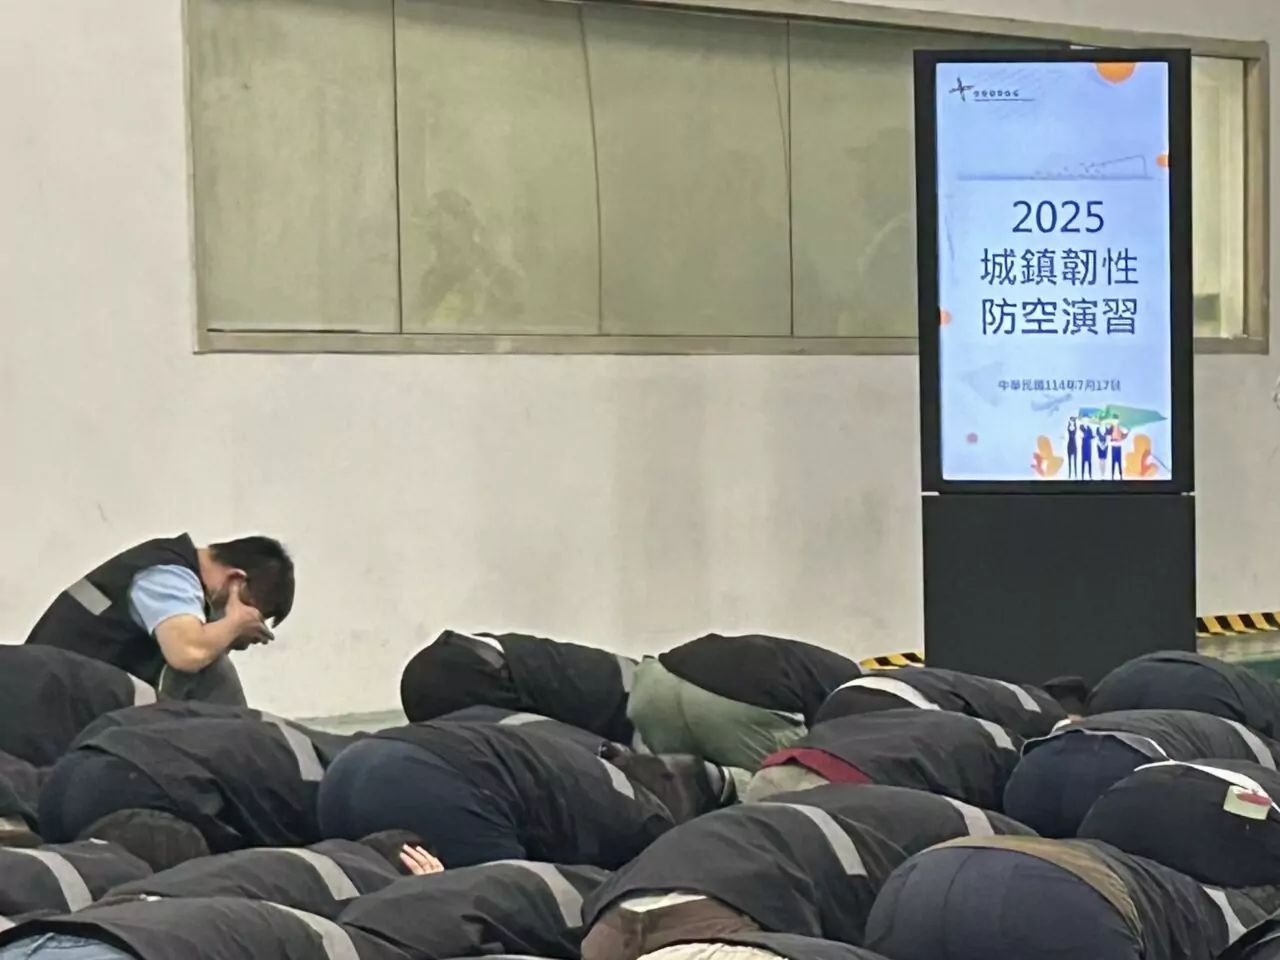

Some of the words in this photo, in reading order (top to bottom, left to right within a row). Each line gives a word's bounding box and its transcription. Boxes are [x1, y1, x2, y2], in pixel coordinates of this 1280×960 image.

[1012, 201, 1105, 233] 2025
[980, 247, 1140, 286] 城鎮韌性
[982, 297, 1138, 336] 防空演習
